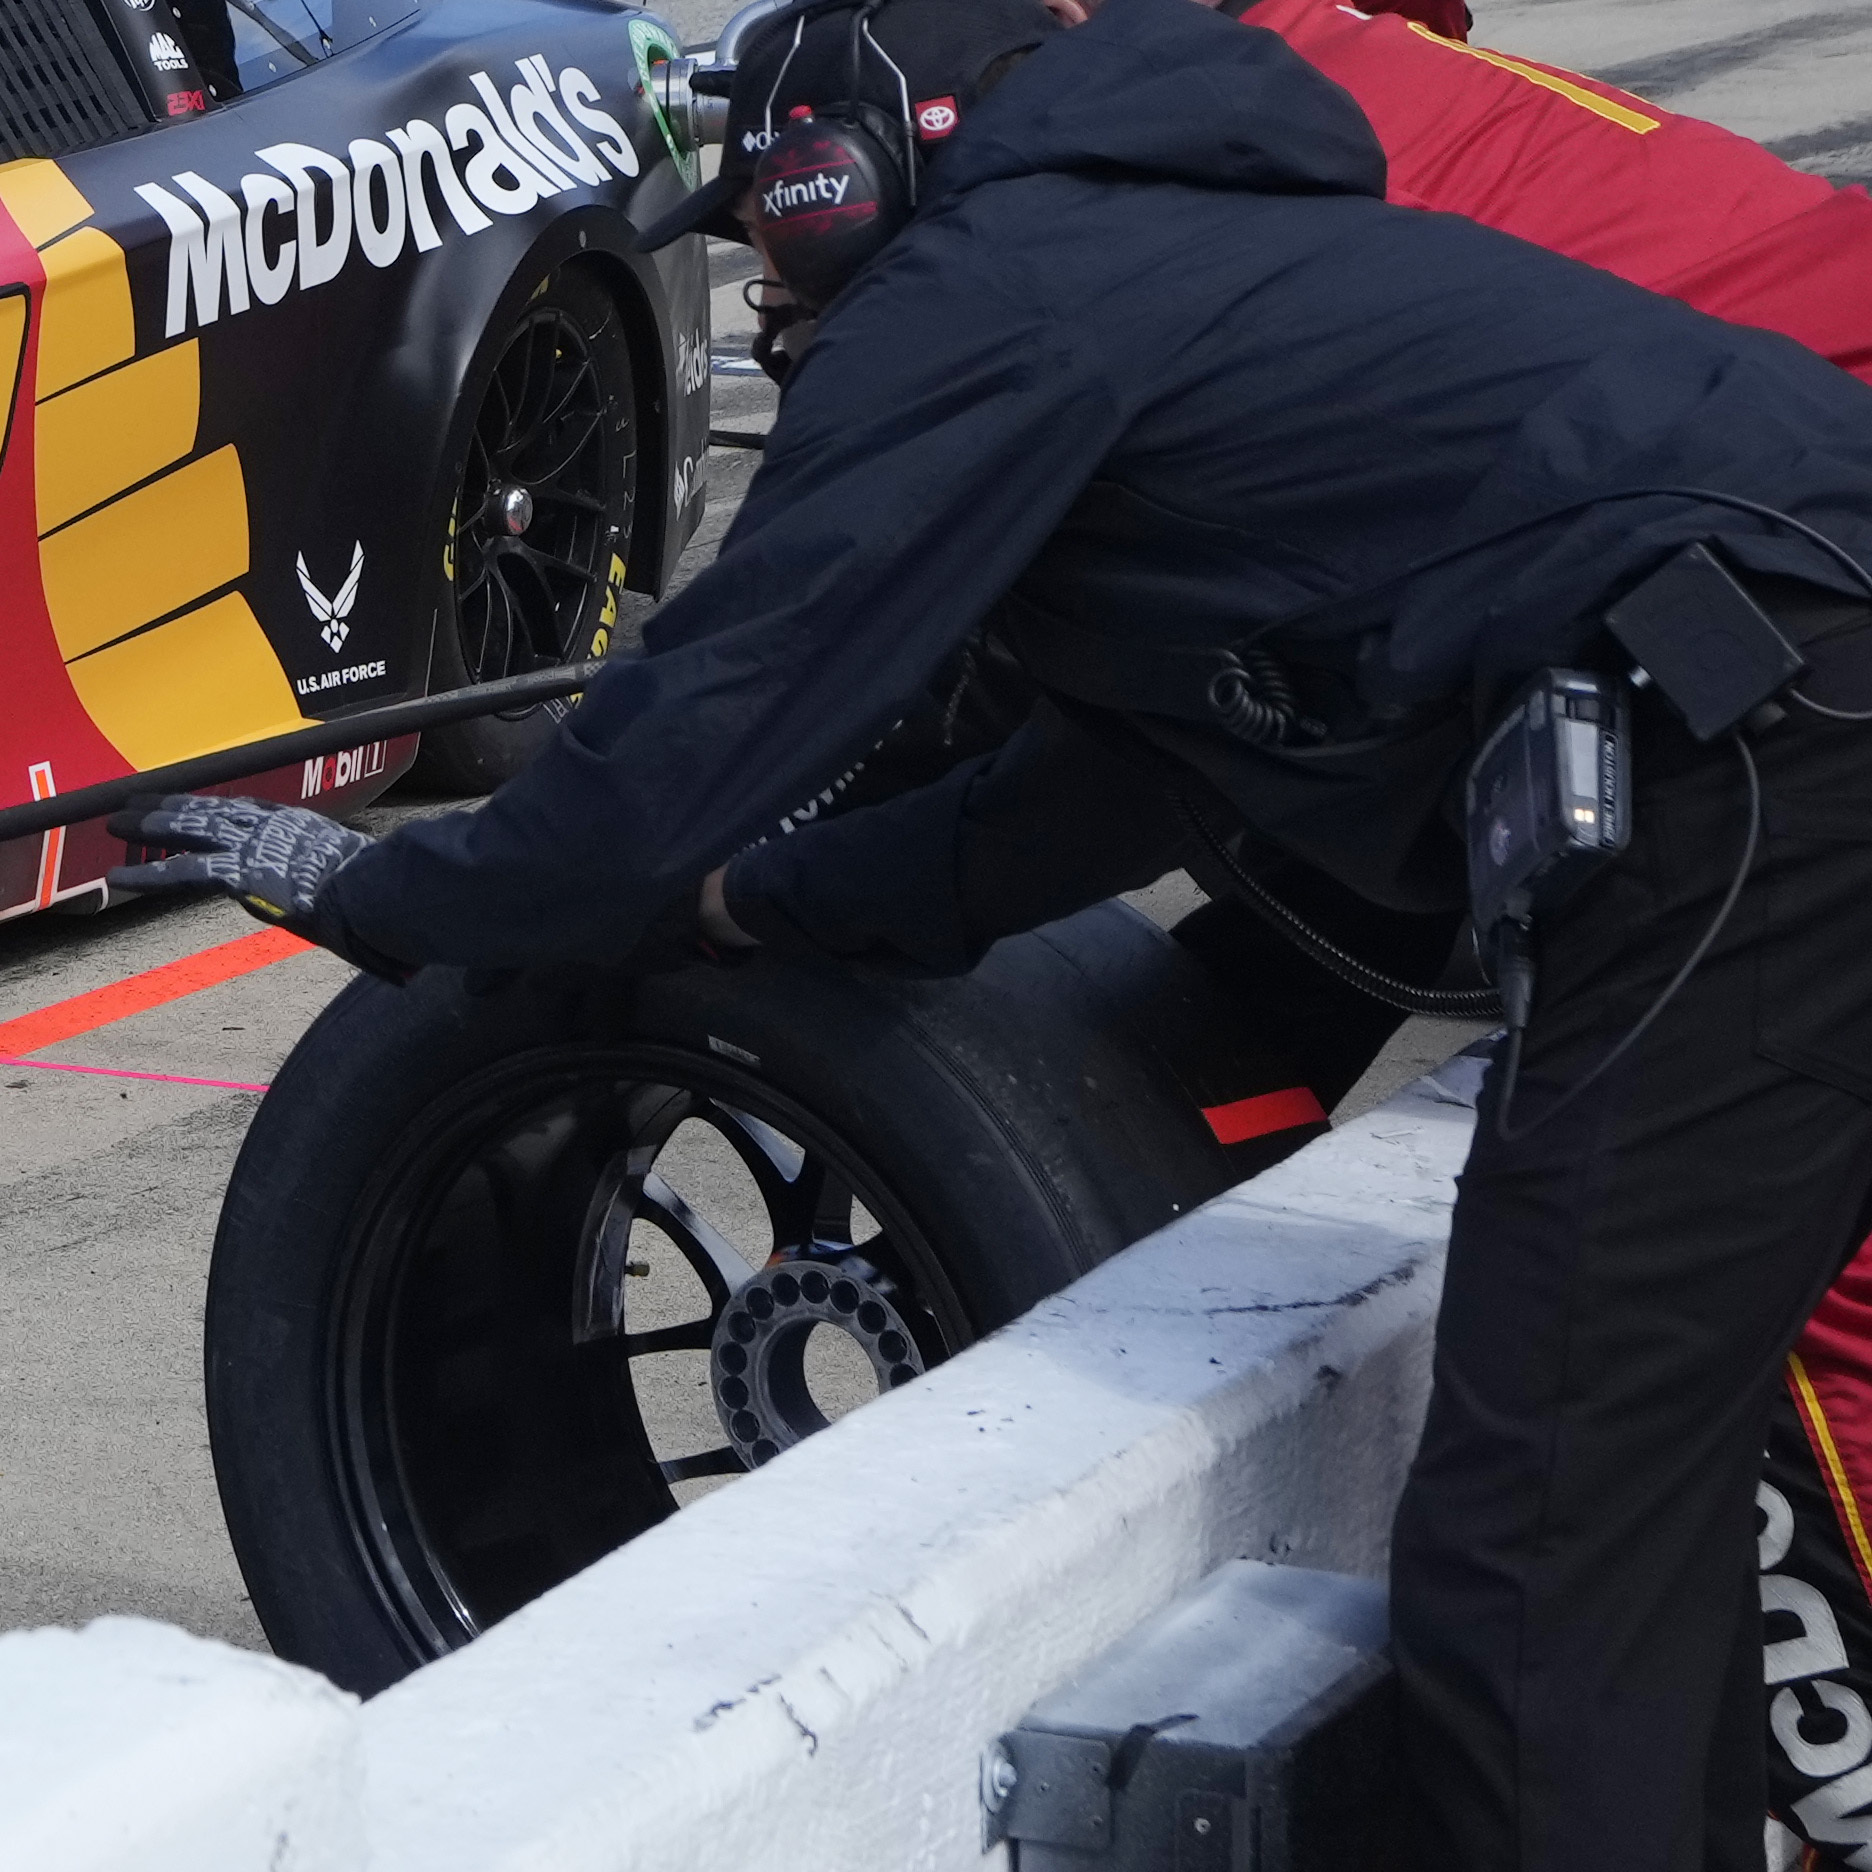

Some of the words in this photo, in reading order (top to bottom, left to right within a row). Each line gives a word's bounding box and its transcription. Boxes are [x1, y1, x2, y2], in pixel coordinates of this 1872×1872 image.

[149, 32, 185, 61] MAC
[153, 58, 189, 72] TOOLS
[133, 52, 641, 340] McDonald's
[762, 171, 851, 217] xfinity
[297, 677, 321, 696] U.S.
[320, 671, 342, 690] AIR
[342, 659, 387, 685] FORCE
[300, 744, 364, 800] Mobil
